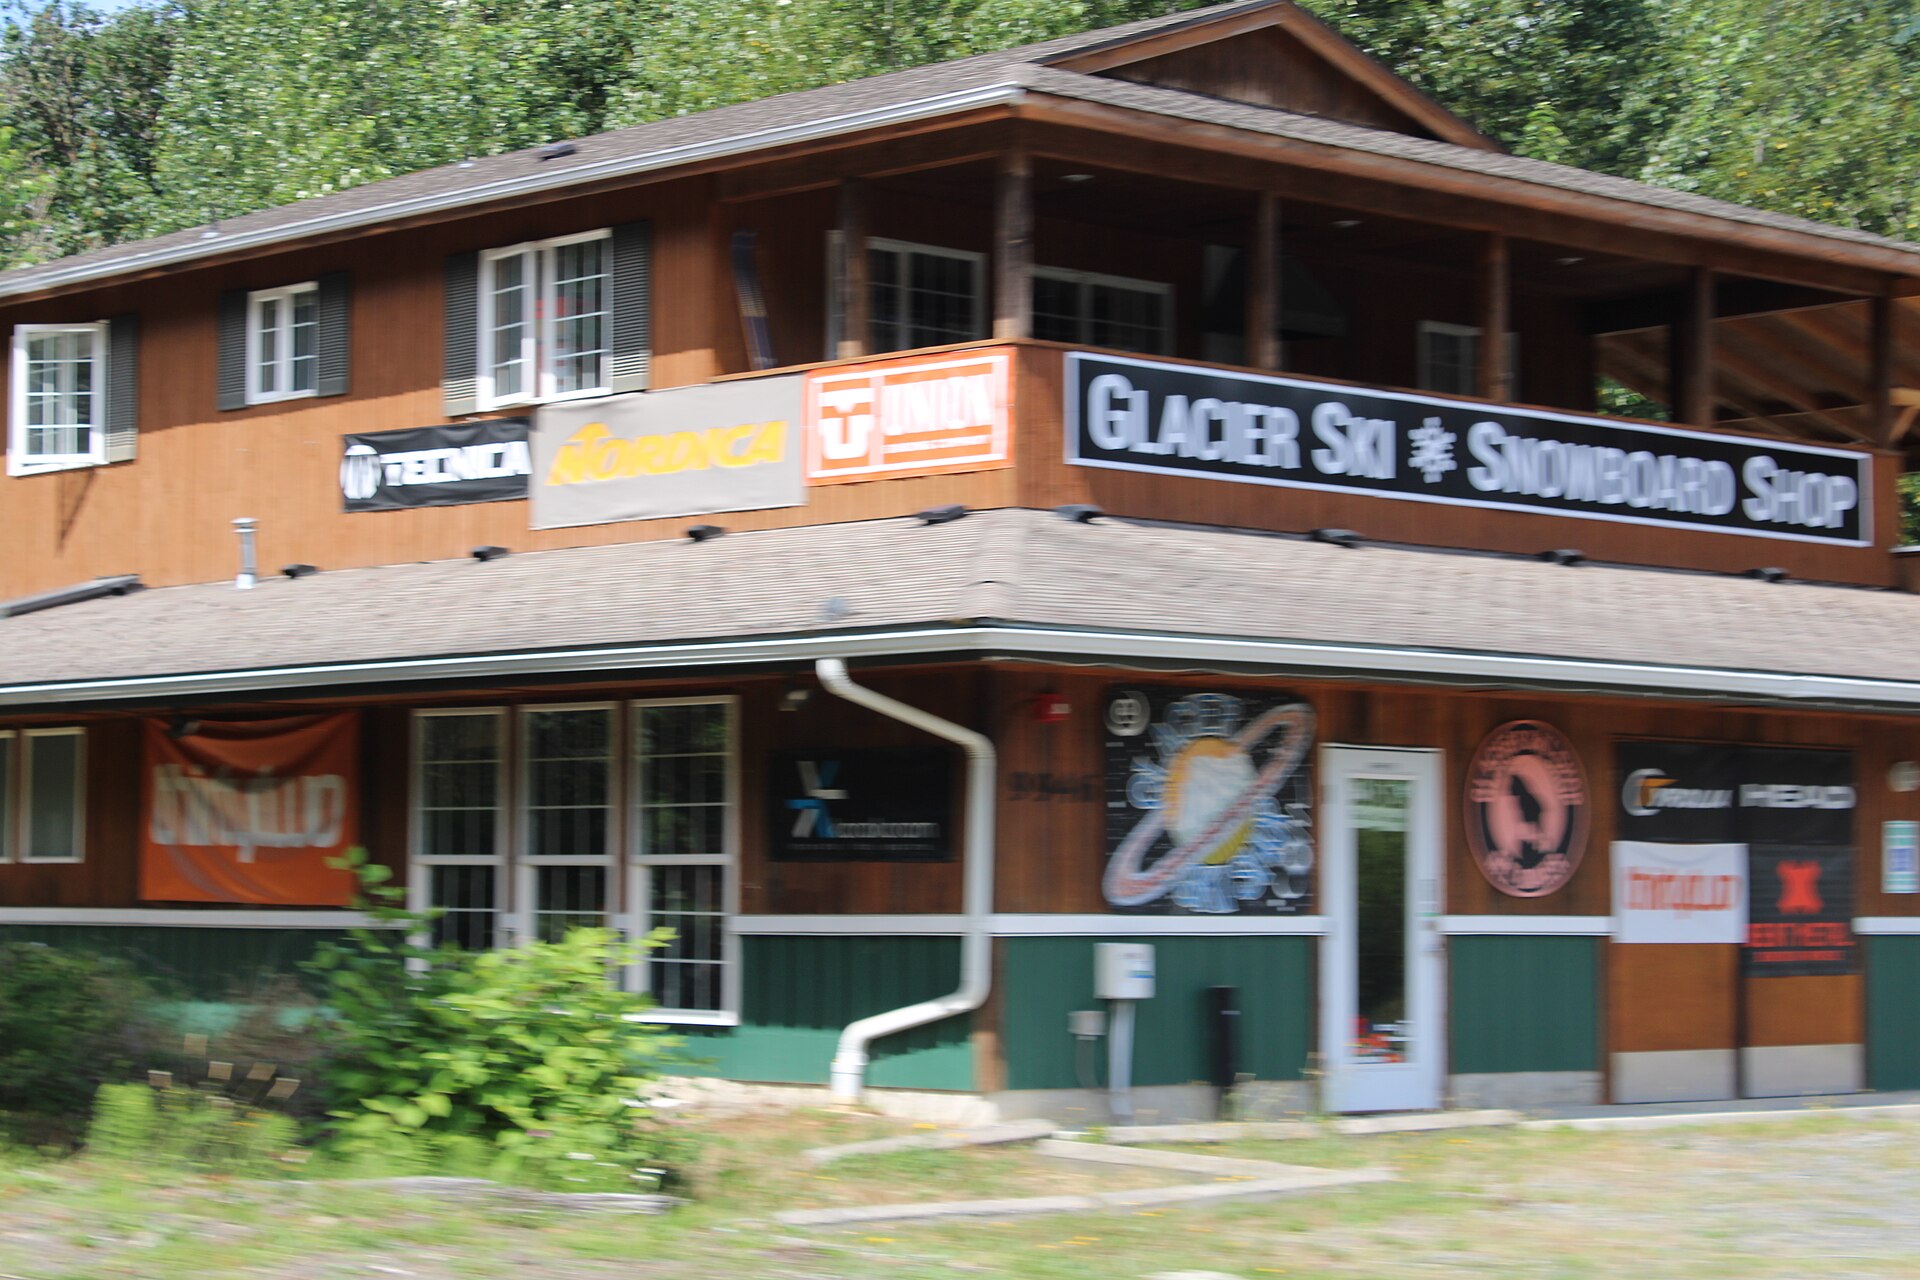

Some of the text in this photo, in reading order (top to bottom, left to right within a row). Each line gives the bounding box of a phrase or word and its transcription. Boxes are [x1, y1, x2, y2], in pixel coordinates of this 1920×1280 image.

[881, 373, 993, 436] UNION
[378, 440, 533, 487] TECNICA
[546, 421, 789, 487] NORDICA
[1087, 373, 1858, 529] GLACIER SKI SNOWBOARD SHOP
[1739, 784, 1857, 809] HEAD
